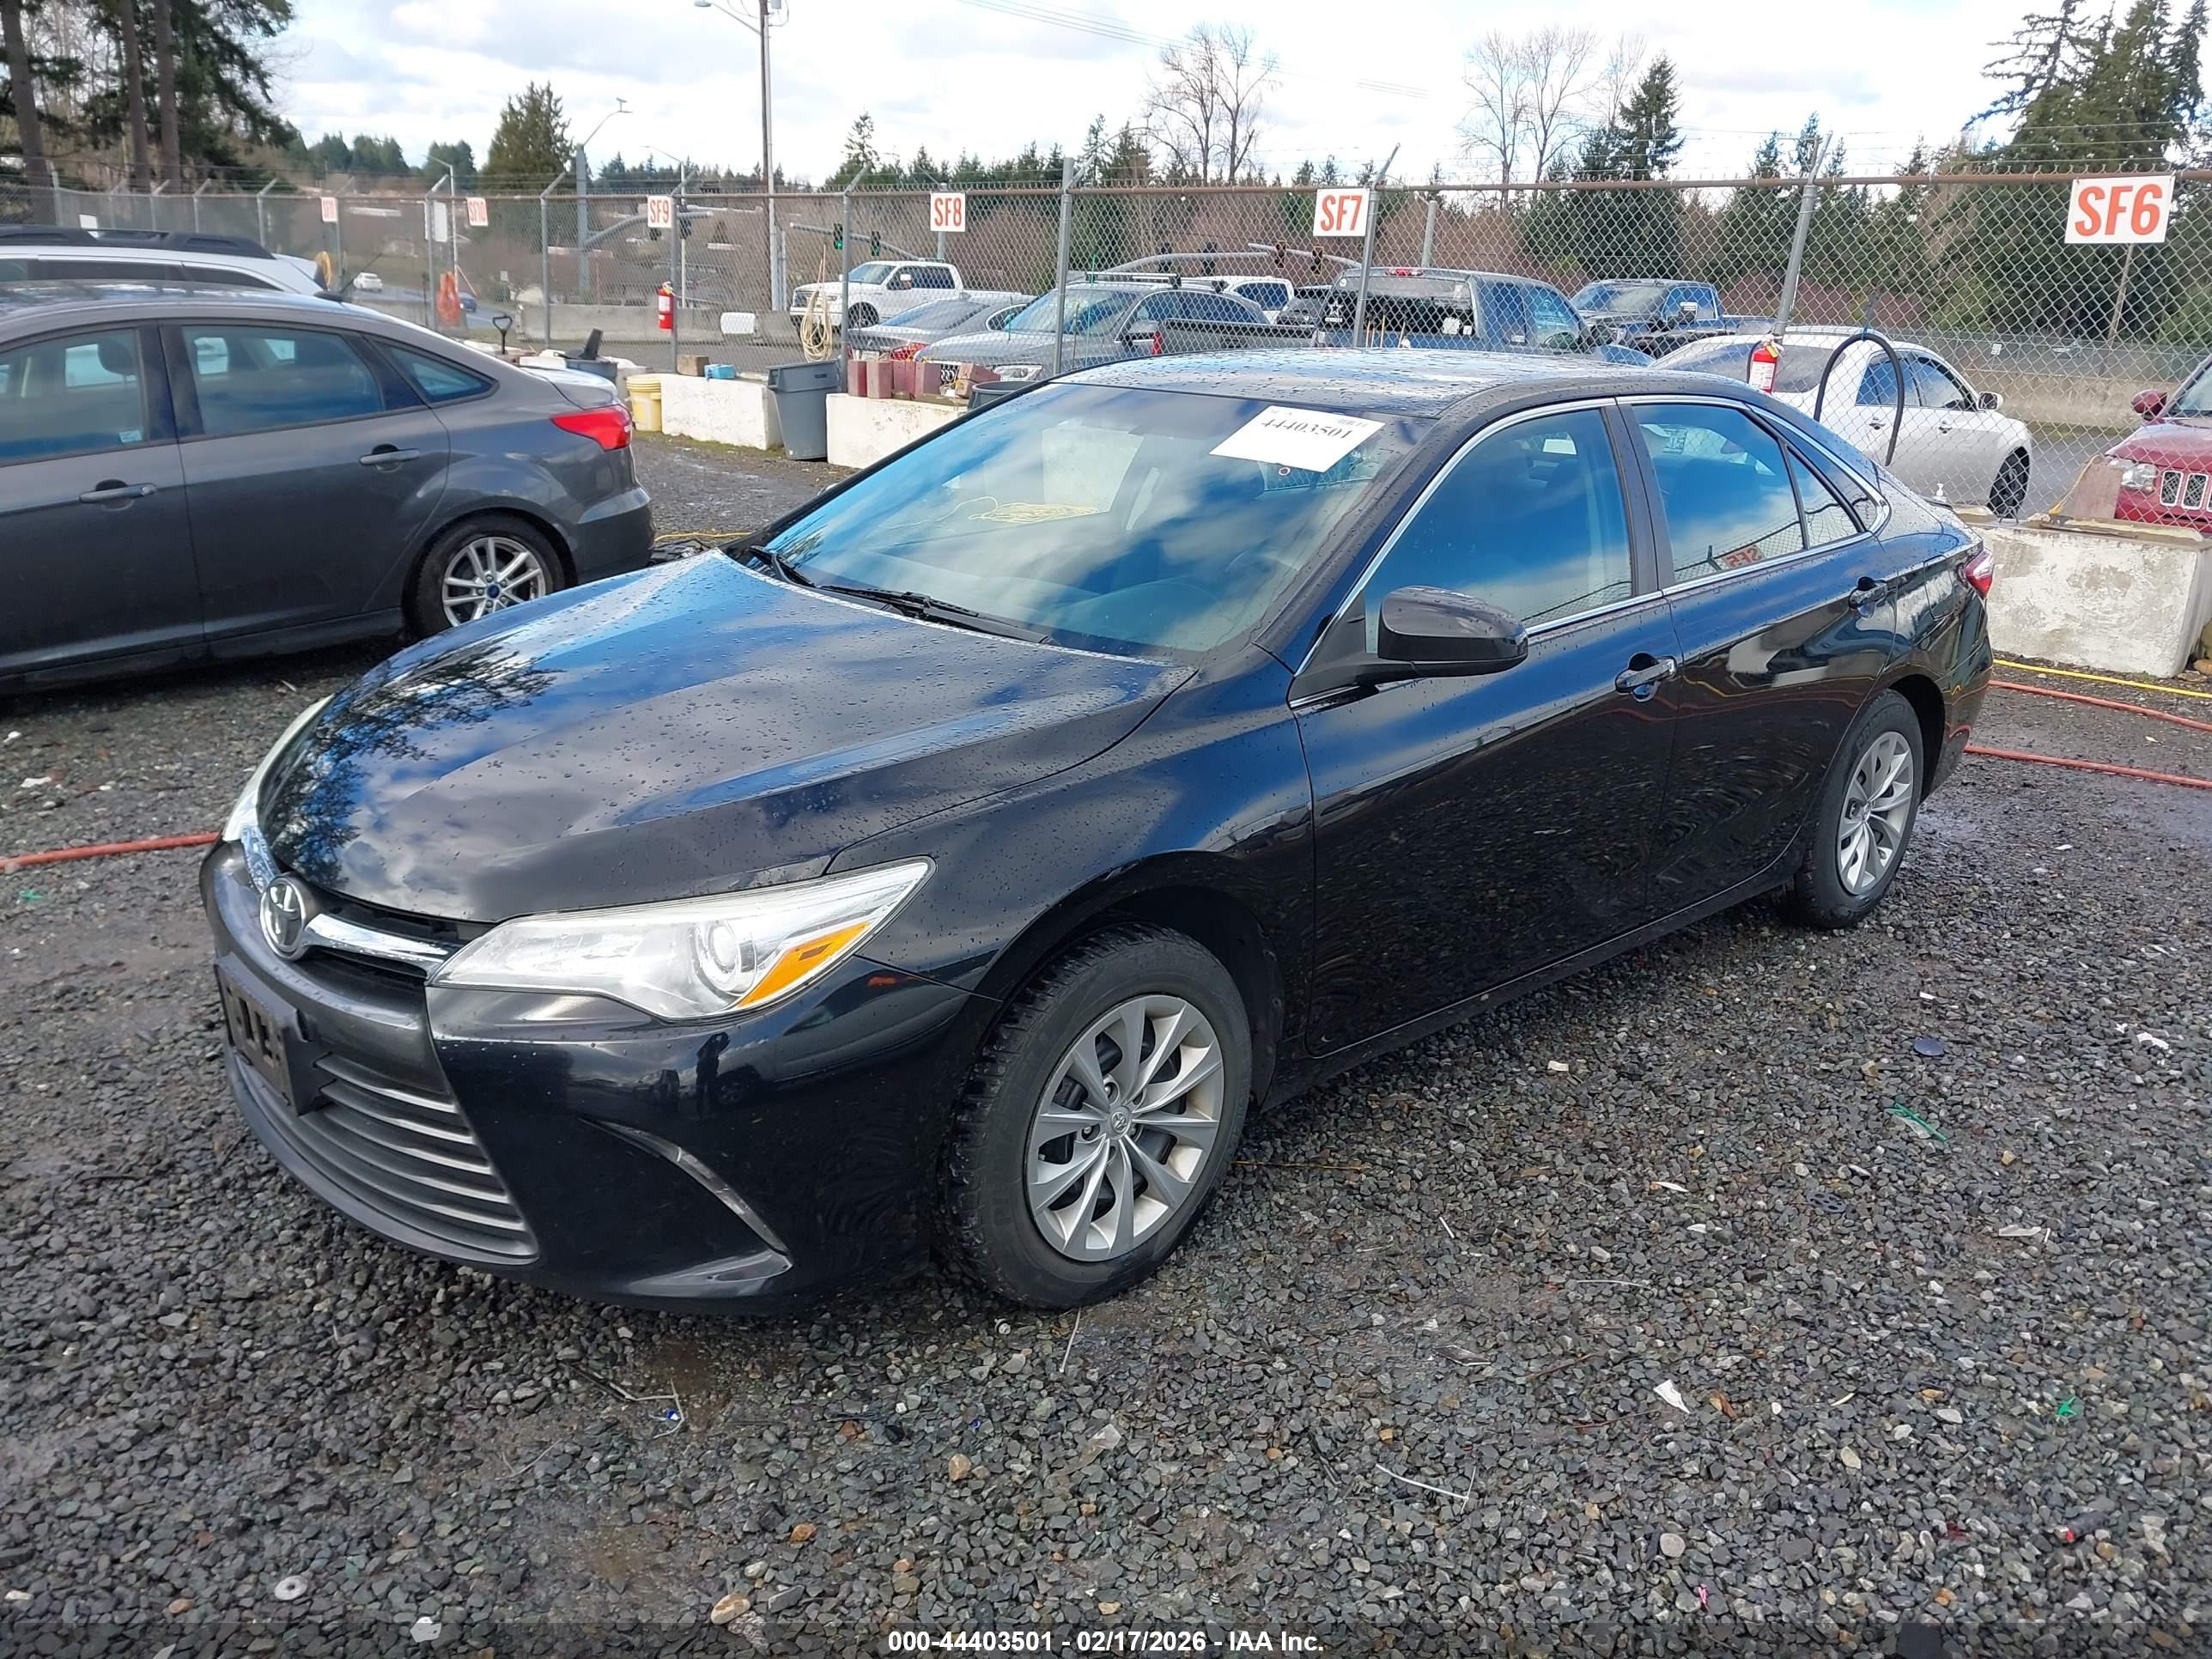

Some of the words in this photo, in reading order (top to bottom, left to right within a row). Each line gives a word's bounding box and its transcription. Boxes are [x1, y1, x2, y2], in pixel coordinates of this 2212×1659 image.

[650, 198, 669, 223] SF9
[934, 198, 962, 227] SF8
[1320, 194, 1363, 232] SF7
[2075, 183, 2163, 237] SF6
[1261, 418, 1353, 439] 44403501
